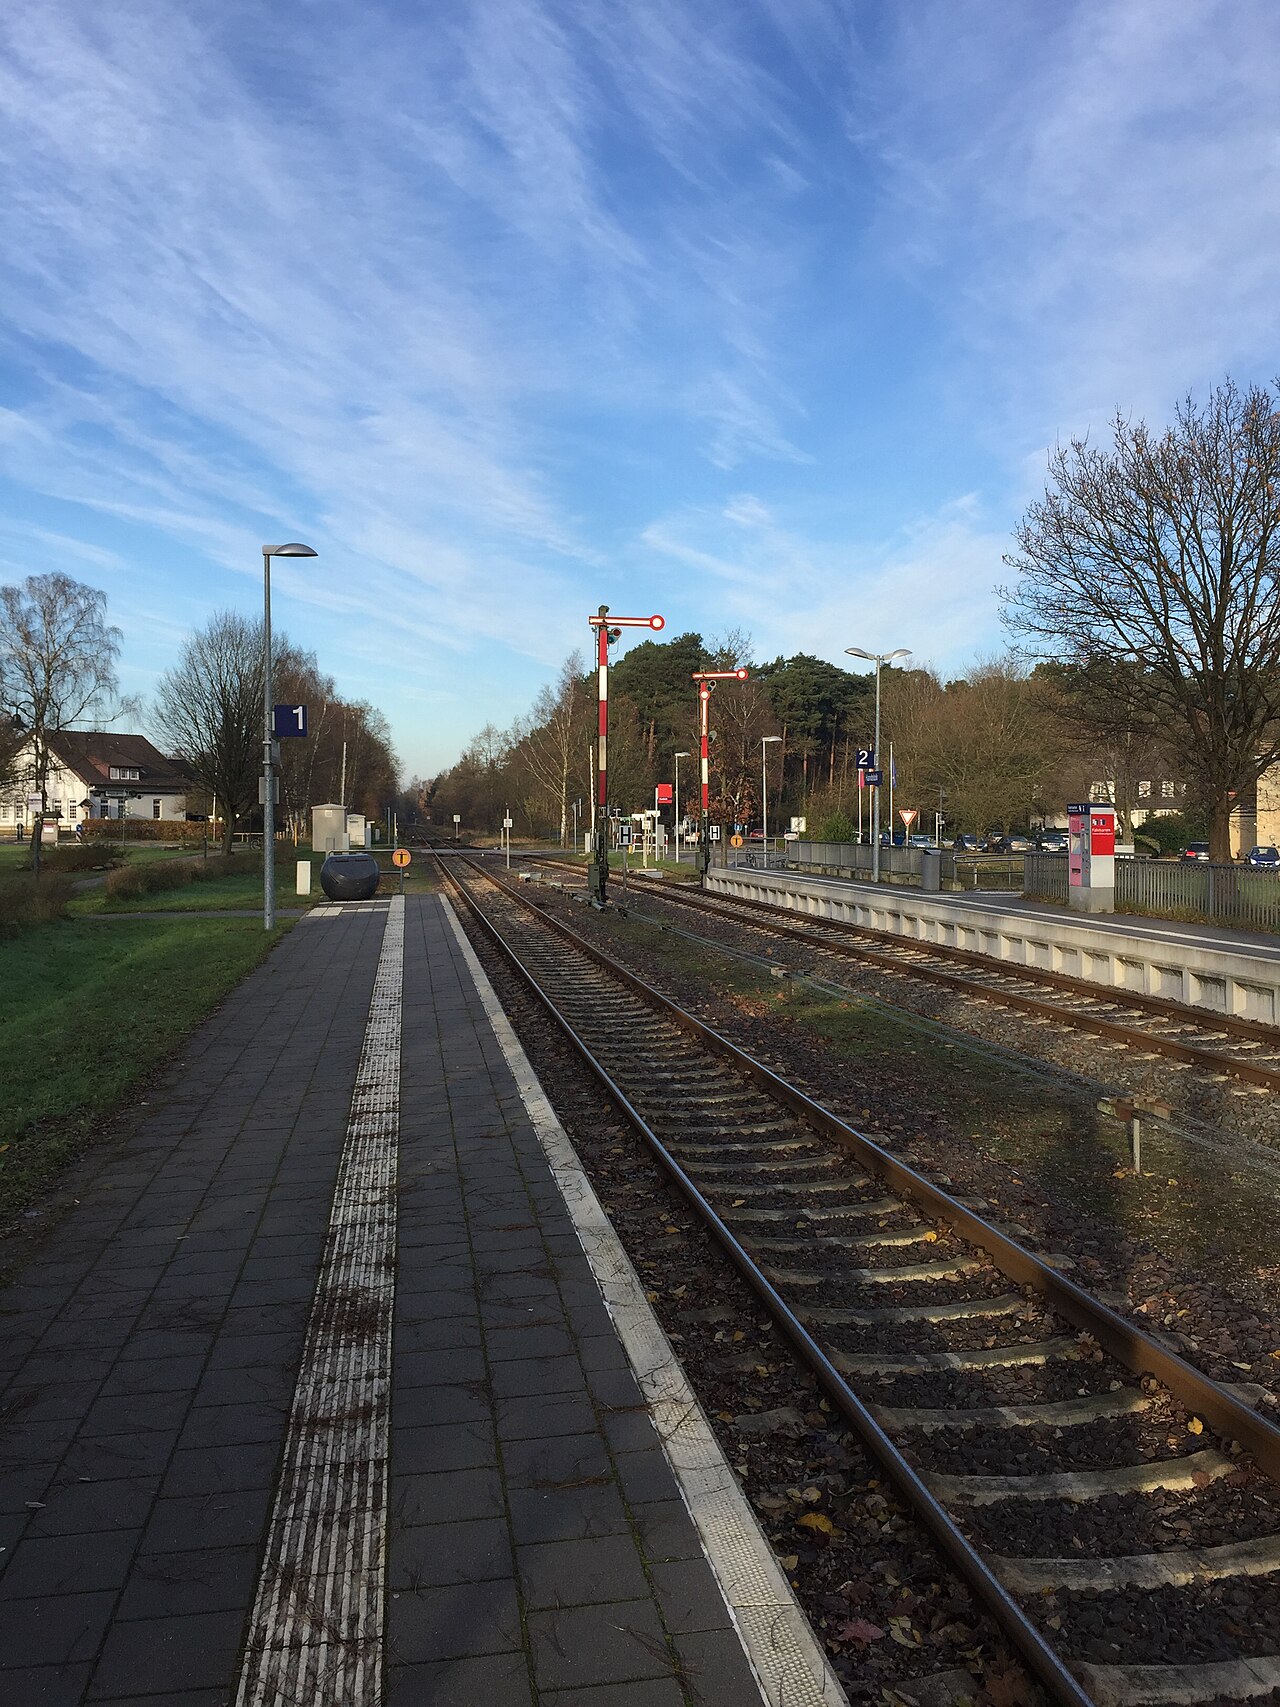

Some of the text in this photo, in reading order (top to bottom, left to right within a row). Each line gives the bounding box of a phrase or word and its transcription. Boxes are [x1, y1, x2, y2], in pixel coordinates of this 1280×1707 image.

[292, 706, 303, 730] 1
[858, 750, 868, 765] 2
[620, 826, 631, 843] H
[711, 827, 719, 839] H
[396, 853, 407, 864] T
